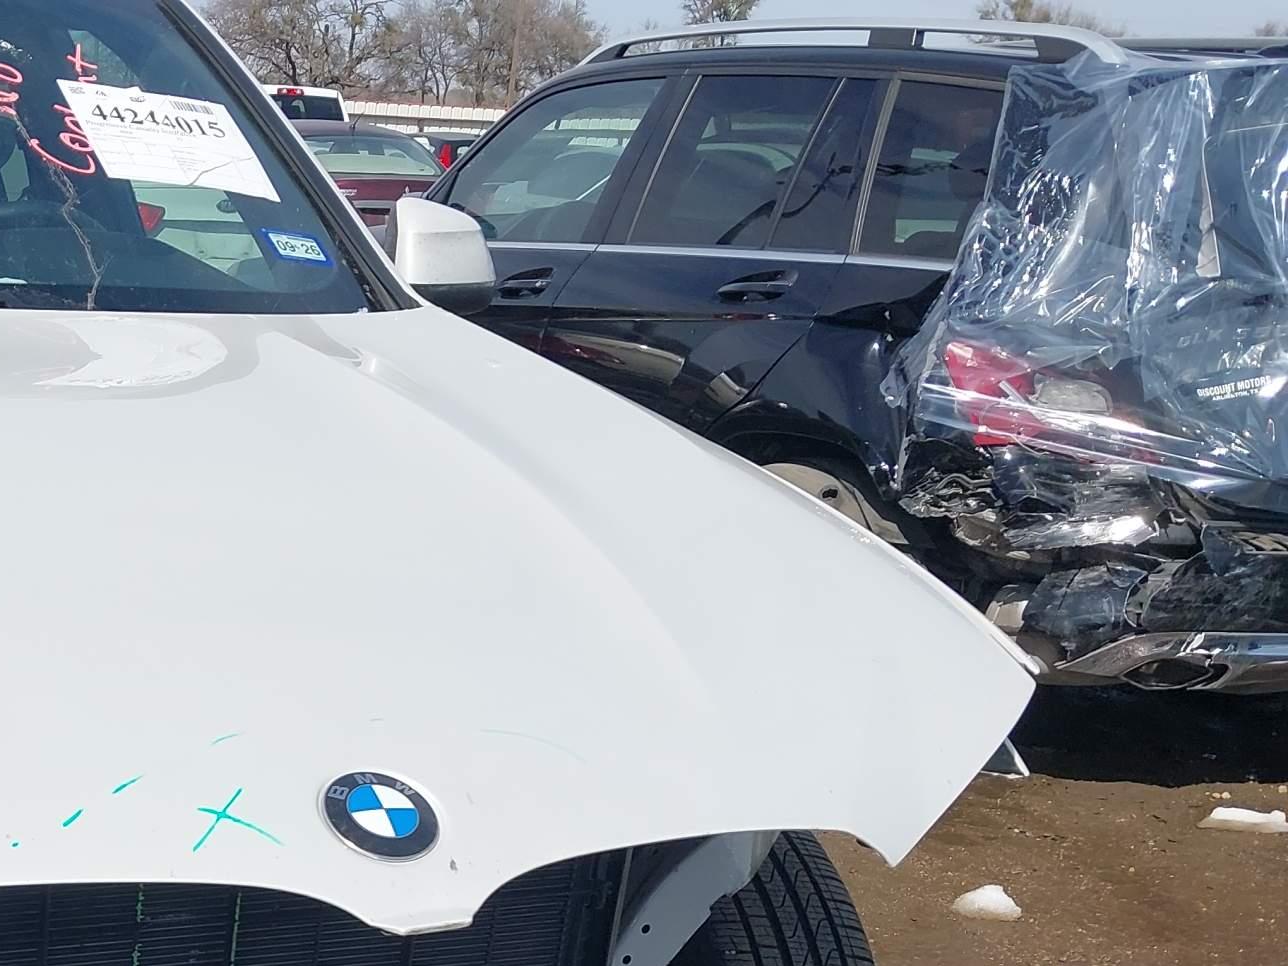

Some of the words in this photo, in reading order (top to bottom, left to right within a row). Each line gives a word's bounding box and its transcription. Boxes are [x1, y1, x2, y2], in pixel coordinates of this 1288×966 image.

[91, 103, 226, 138] 44244015
[1196, 382, 1236, 397] DISCOUNT
[327, 773, 416, 800] BMW
